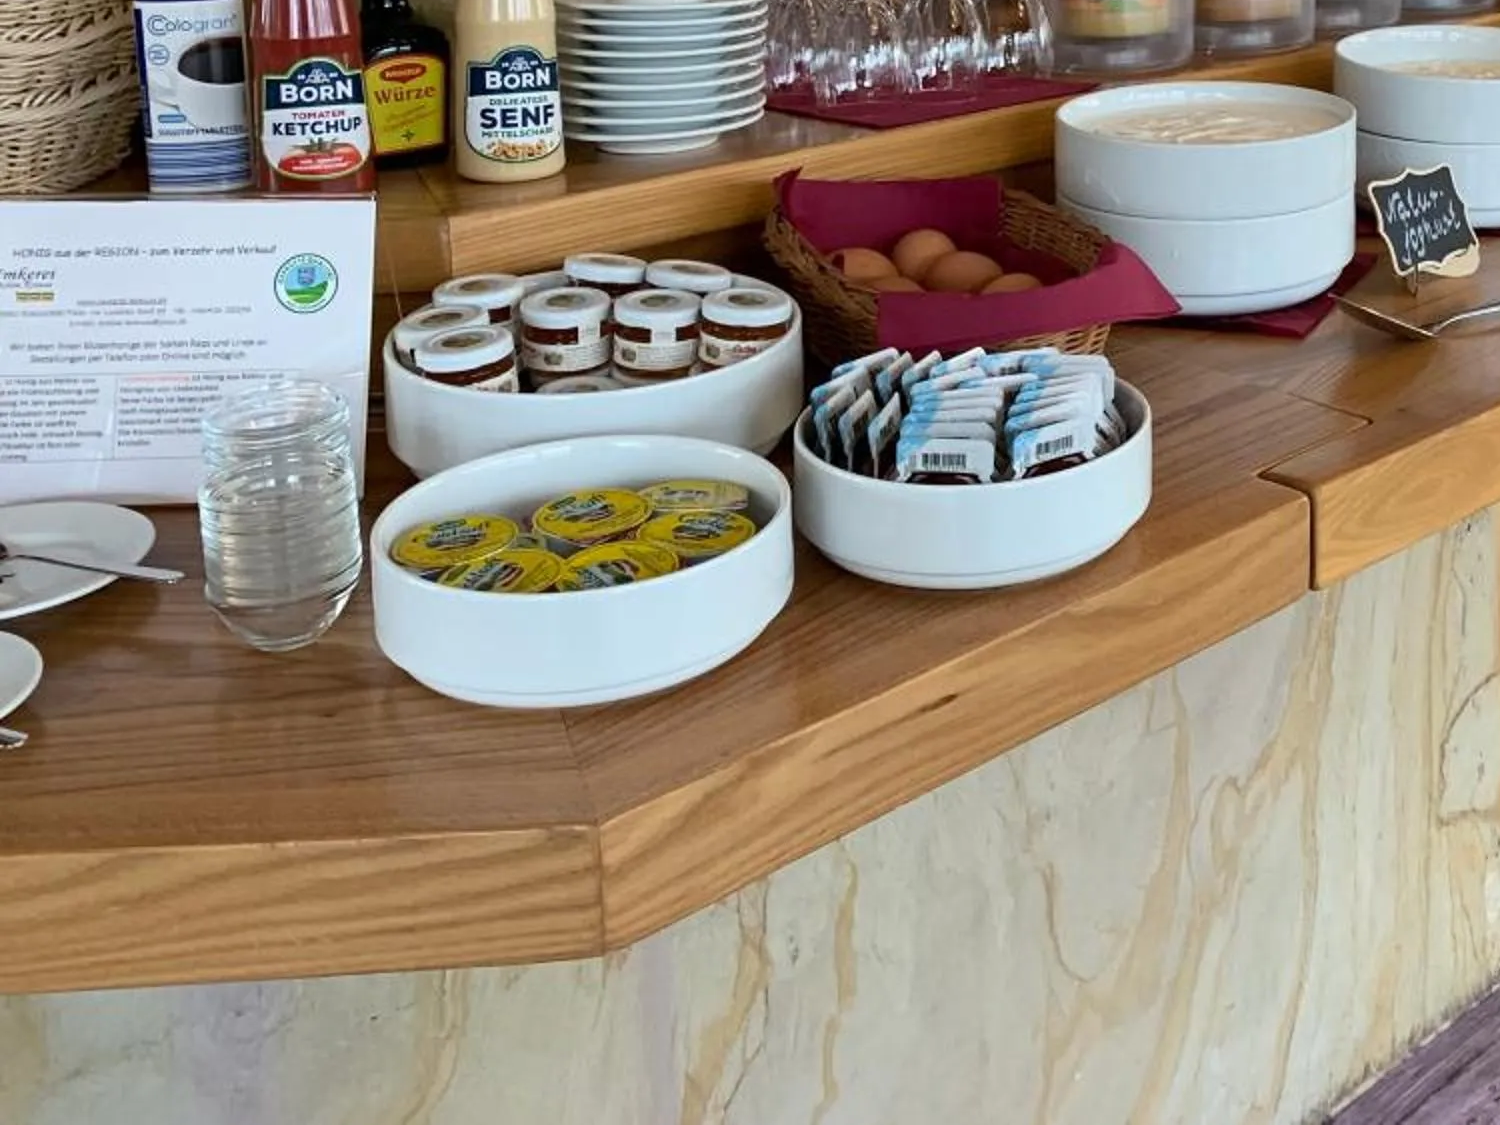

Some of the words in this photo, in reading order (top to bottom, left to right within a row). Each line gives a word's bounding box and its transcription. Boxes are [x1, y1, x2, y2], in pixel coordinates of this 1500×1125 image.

[484, 66, 551, 90] BORN
[279, 78, 354, 104] BORN
[374, 86, 438, 105] Würze
[292, 109, 346, 120] TOMATEN
[480, 104, 555, 130] SENF
[272, 116, 363, 136] KETCHUP
